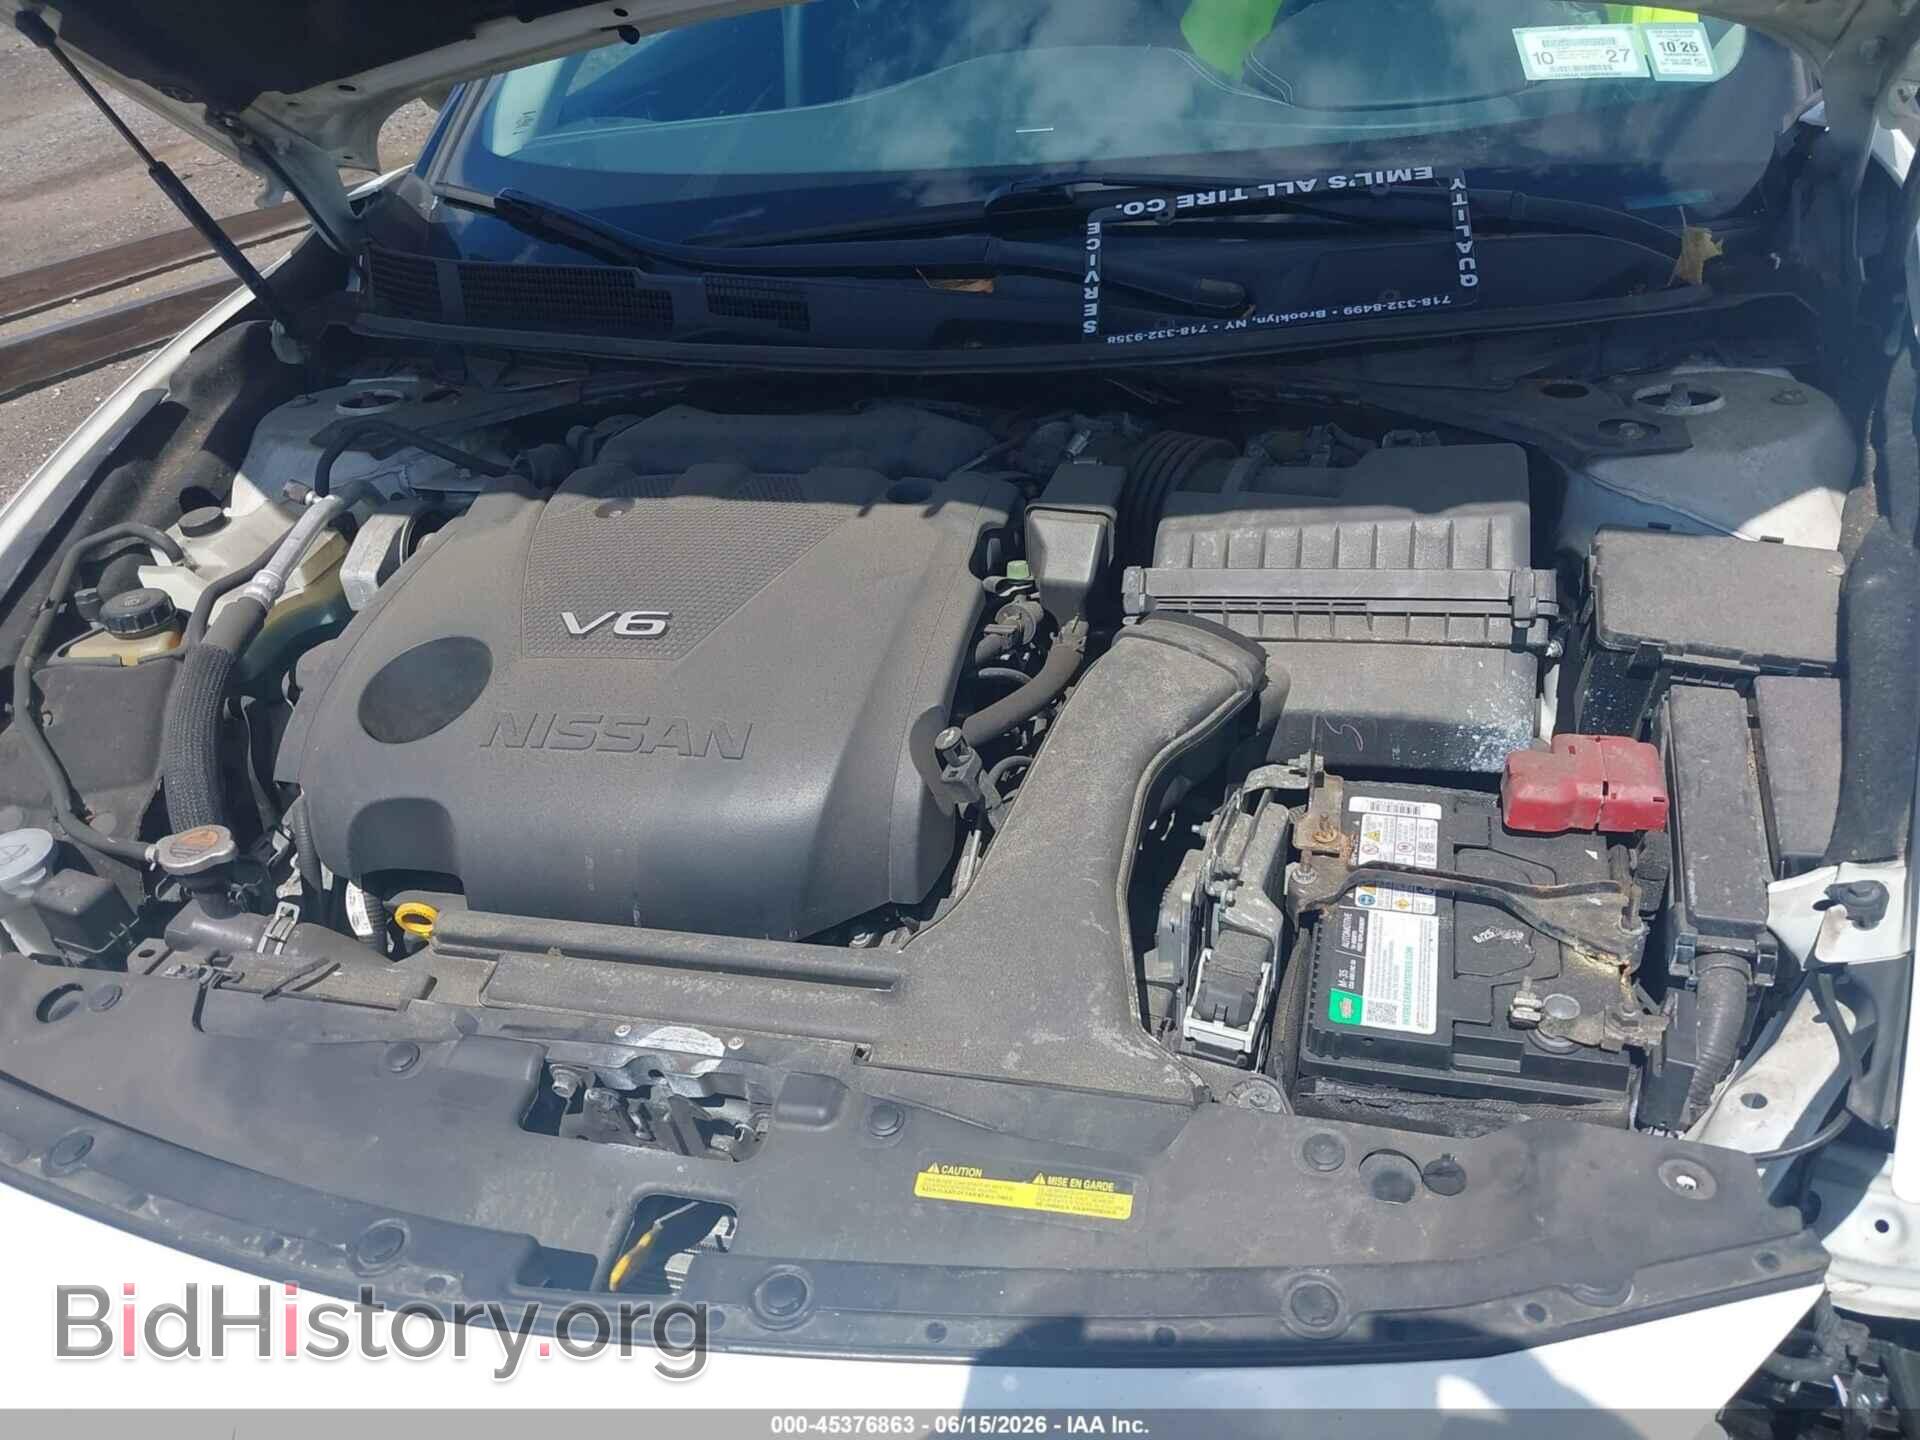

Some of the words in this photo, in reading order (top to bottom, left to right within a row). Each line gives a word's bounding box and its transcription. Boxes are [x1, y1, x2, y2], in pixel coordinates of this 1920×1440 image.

[1533, 51, 1555, 66] 10
[1605, 48, 1630, 64] 27
[1257, 178, 1319, 197] ALL
[1327, 166, 1434, 189] EMIL'S
[1115, 199, 1166, 216] CO.
[1176, 187, 1249, 209] TIRE
[1449, 177, 1479, 287] QUALITY
[1083, 222, 1100, 334] SERVICE
[1343, 295, 1452, 316] 718-332-8499
[1224, 319, 1248, 331] NY
[1252, 307, 1327, 325] Brooklyn,
[560, 611, 672, 640] V6
[480, 712, 752, 760] NISSAN
[941, 1164, 983, 1178] CAUTION
[1047, 1175, 1069, 1188] MISE
[1069, 1177, 1083, 1189] EN
[1083, 1179, 1115, 1193] GARDE
